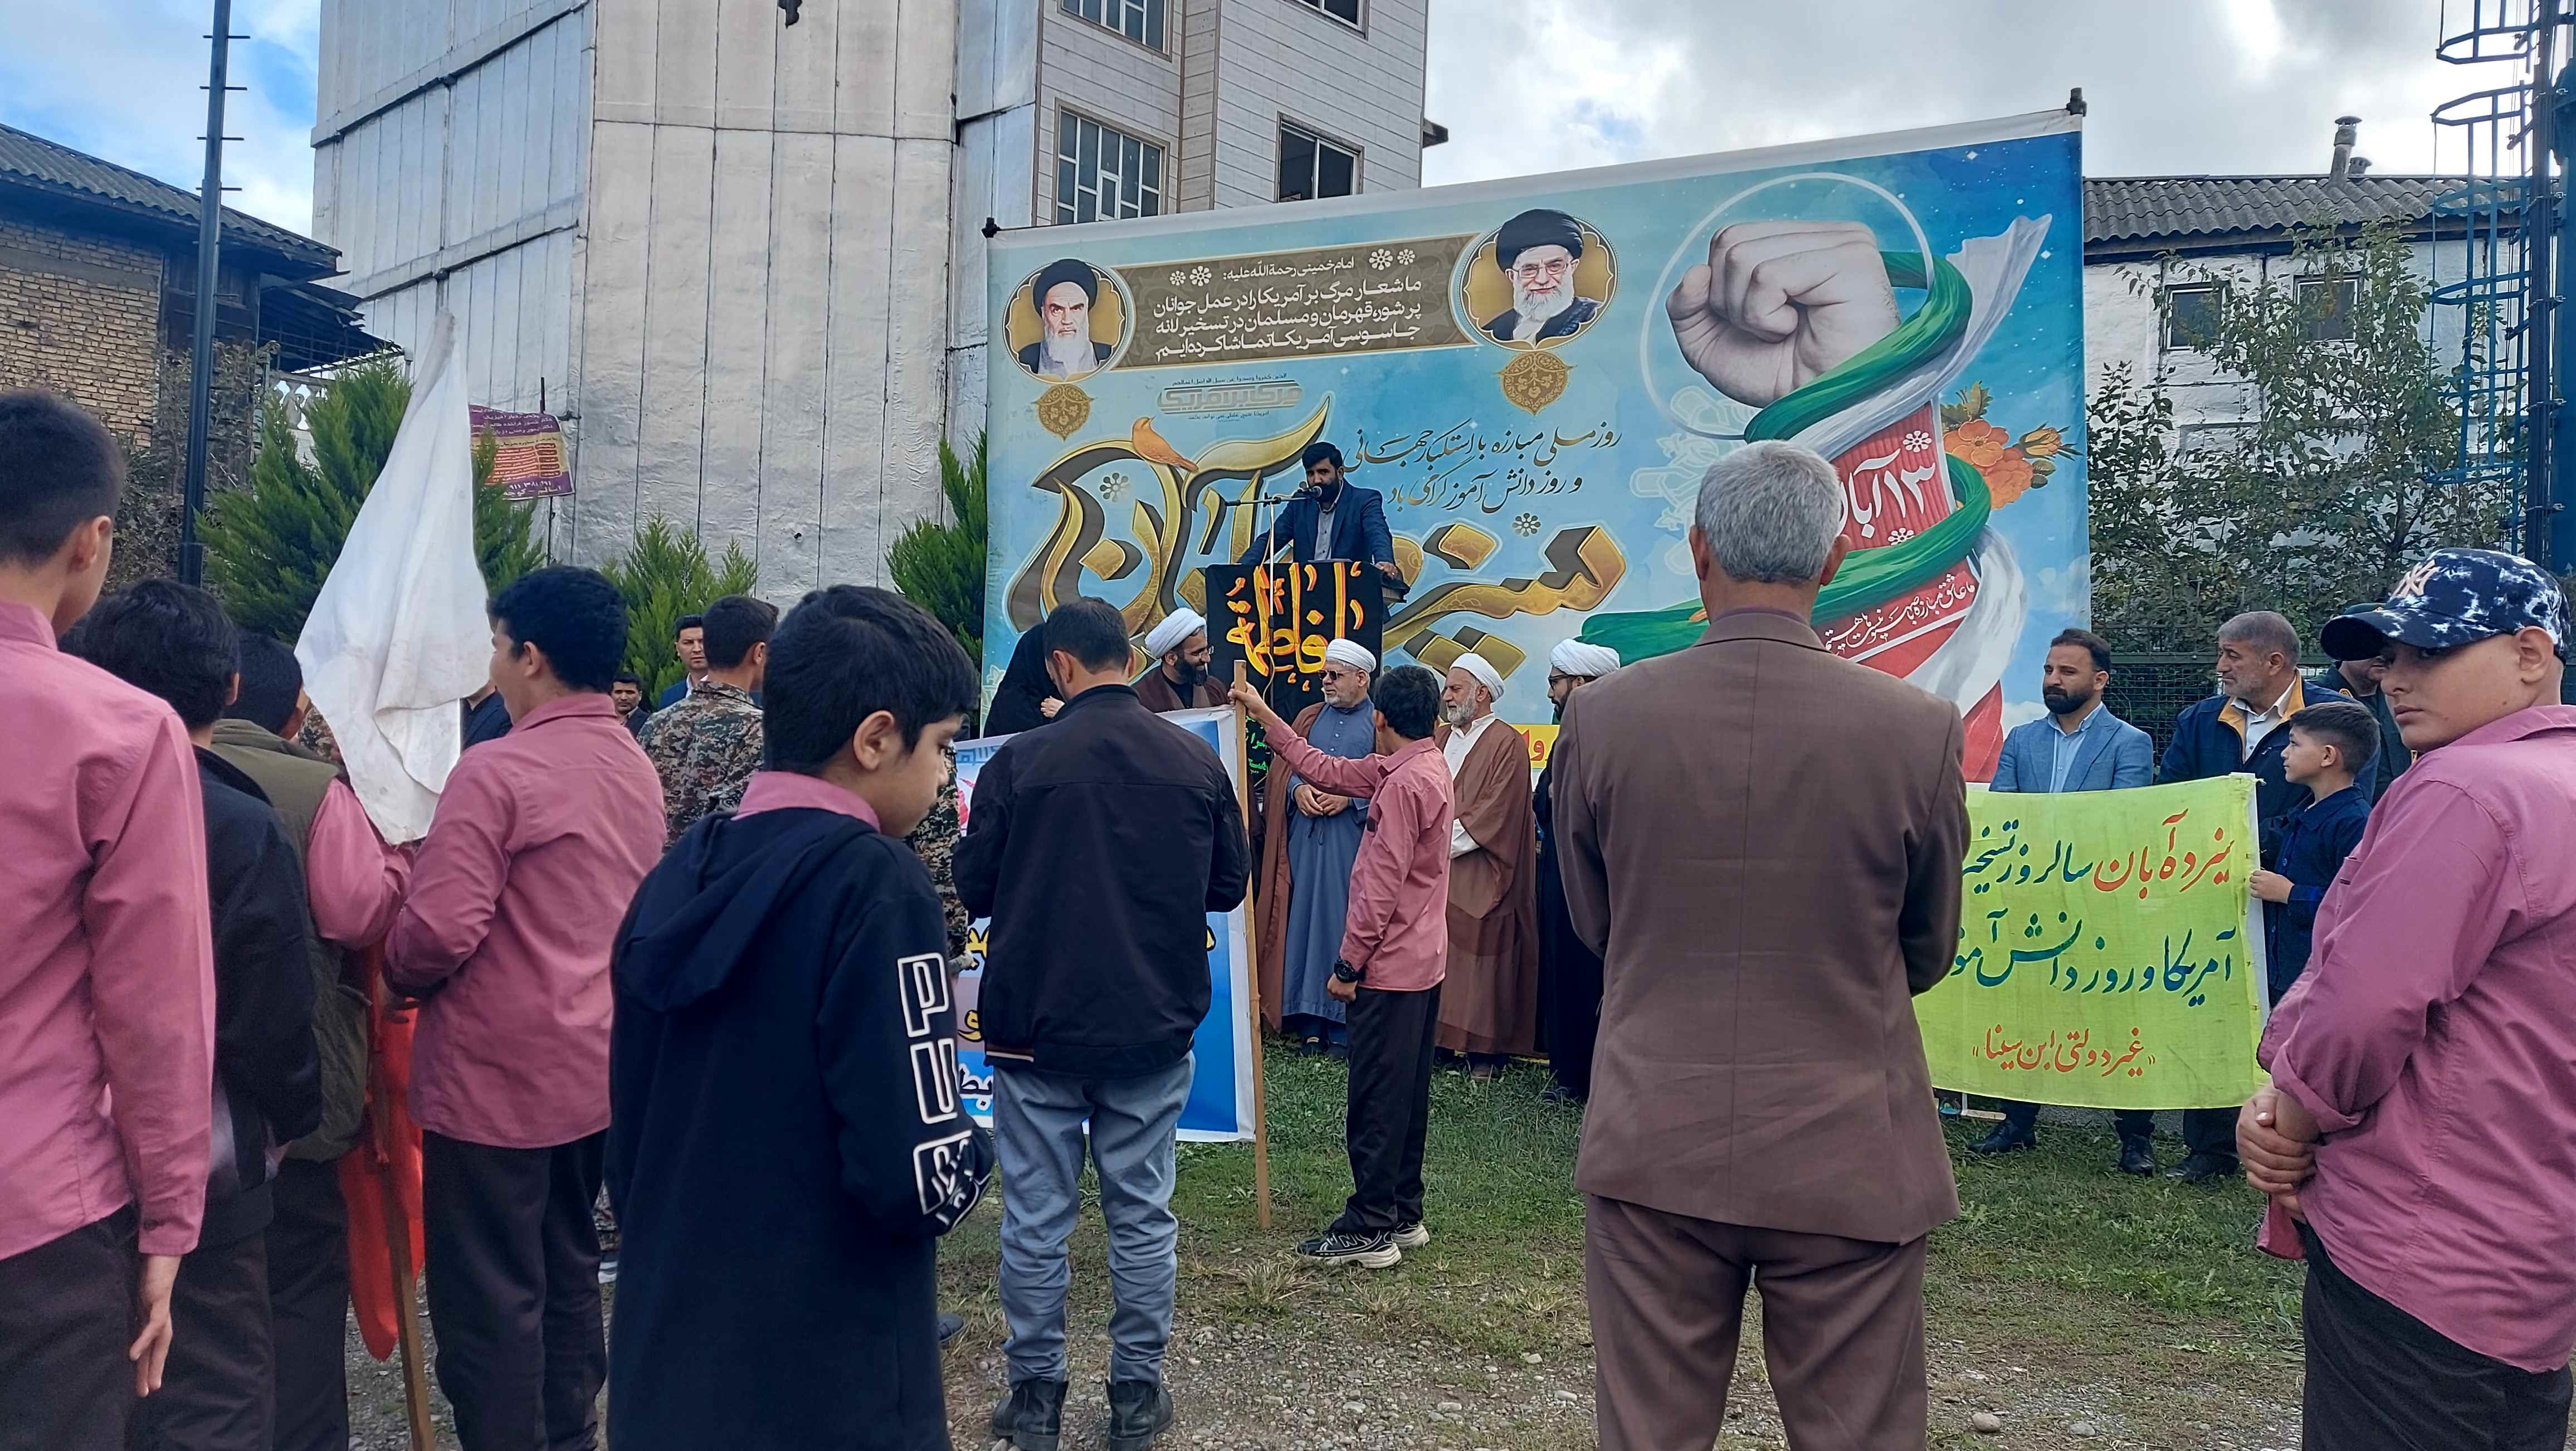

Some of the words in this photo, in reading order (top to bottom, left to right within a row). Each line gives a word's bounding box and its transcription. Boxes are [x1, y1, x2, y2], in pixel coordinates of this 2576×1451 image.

[1297, 259, 1335, 277] خمینی
[1334, 255, 1354, 275] امام
[1320, 280, 1354, 303] مرگ
[1354, 279, 1405, 301] شعار
[1405, 275, 1422, 291] ما
[1153, 295, 1197, 318] جوانان
[1198, 293, 1232, 314] عمل
[1258, 284, 1307, 308] آمریکا
[1304, 289, 1319, 305] بر
[1156, 318, 1179, 333] لانه
[1178, 315, 1230, 336] تسخیر
[1228, 317, 1245, 333] در
[1245, 309, 1309, 332] مسلمان
[1319, 301, 1373, 327] قهرمان
[1223, 333, 1272, 350] تماشا
[1271, 325, 1338, 350] آمریکا
[1333, 321, 1421, 348] جاسوسی
[1414, 417, 1476, 471] استکبار
[1477, 433, 1487, 460] با
[1492, 430, 1544, 460] مبارزه
[1533, 426, 1597, 467] ملی
[1590, 421, 1623, 449] روز
[1343, 429, 1435, 473] جهانی
[1408, 455, 1475, 507] گرامی
[1536, 470, 1567, 495] روز
[1568, 475, 1583, 494] و
[1387, 483, 1404, 513] باد
[2094, 808, 2189, 899] آبان
[1950, 908, 2008, 977] آمو
[2163, 926, 2236, 1007] آمریکا
